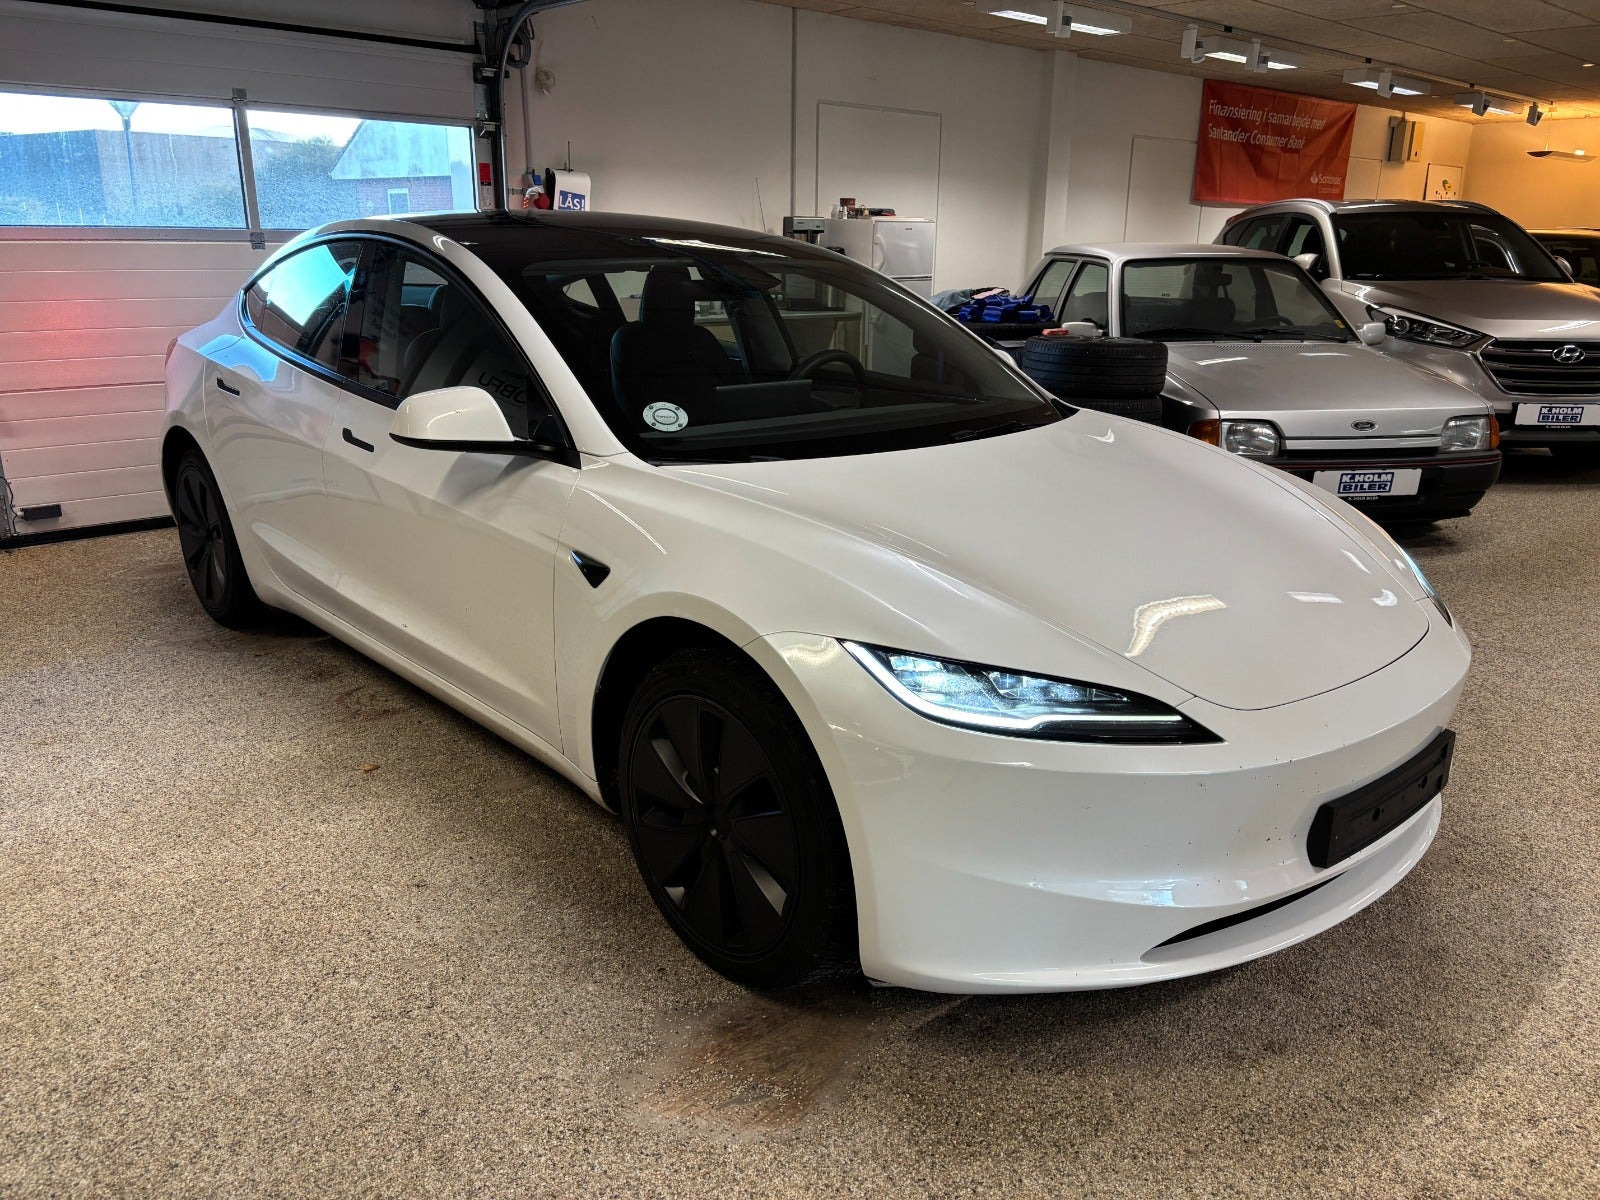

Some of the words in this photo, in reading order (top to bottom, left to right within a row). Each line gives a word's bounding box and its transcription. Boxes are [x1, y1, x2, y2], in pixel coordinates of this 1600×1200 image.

[1208, 100, 1261, 125] Finansiering
[1268, 110, 1311, 131] samarbejde
[1310, 117, 1327, 130] med
[1208, 123, 1250, 143] Santander
[1250, 130, 1289, 148] Consumer
[1288, 135, 1306, 149] Bank
[559, 193, 585, 211] LÅS!
[1341, 474, 1392, 482] K.HOLM
[1342, 483, 1388, 491] BILER
